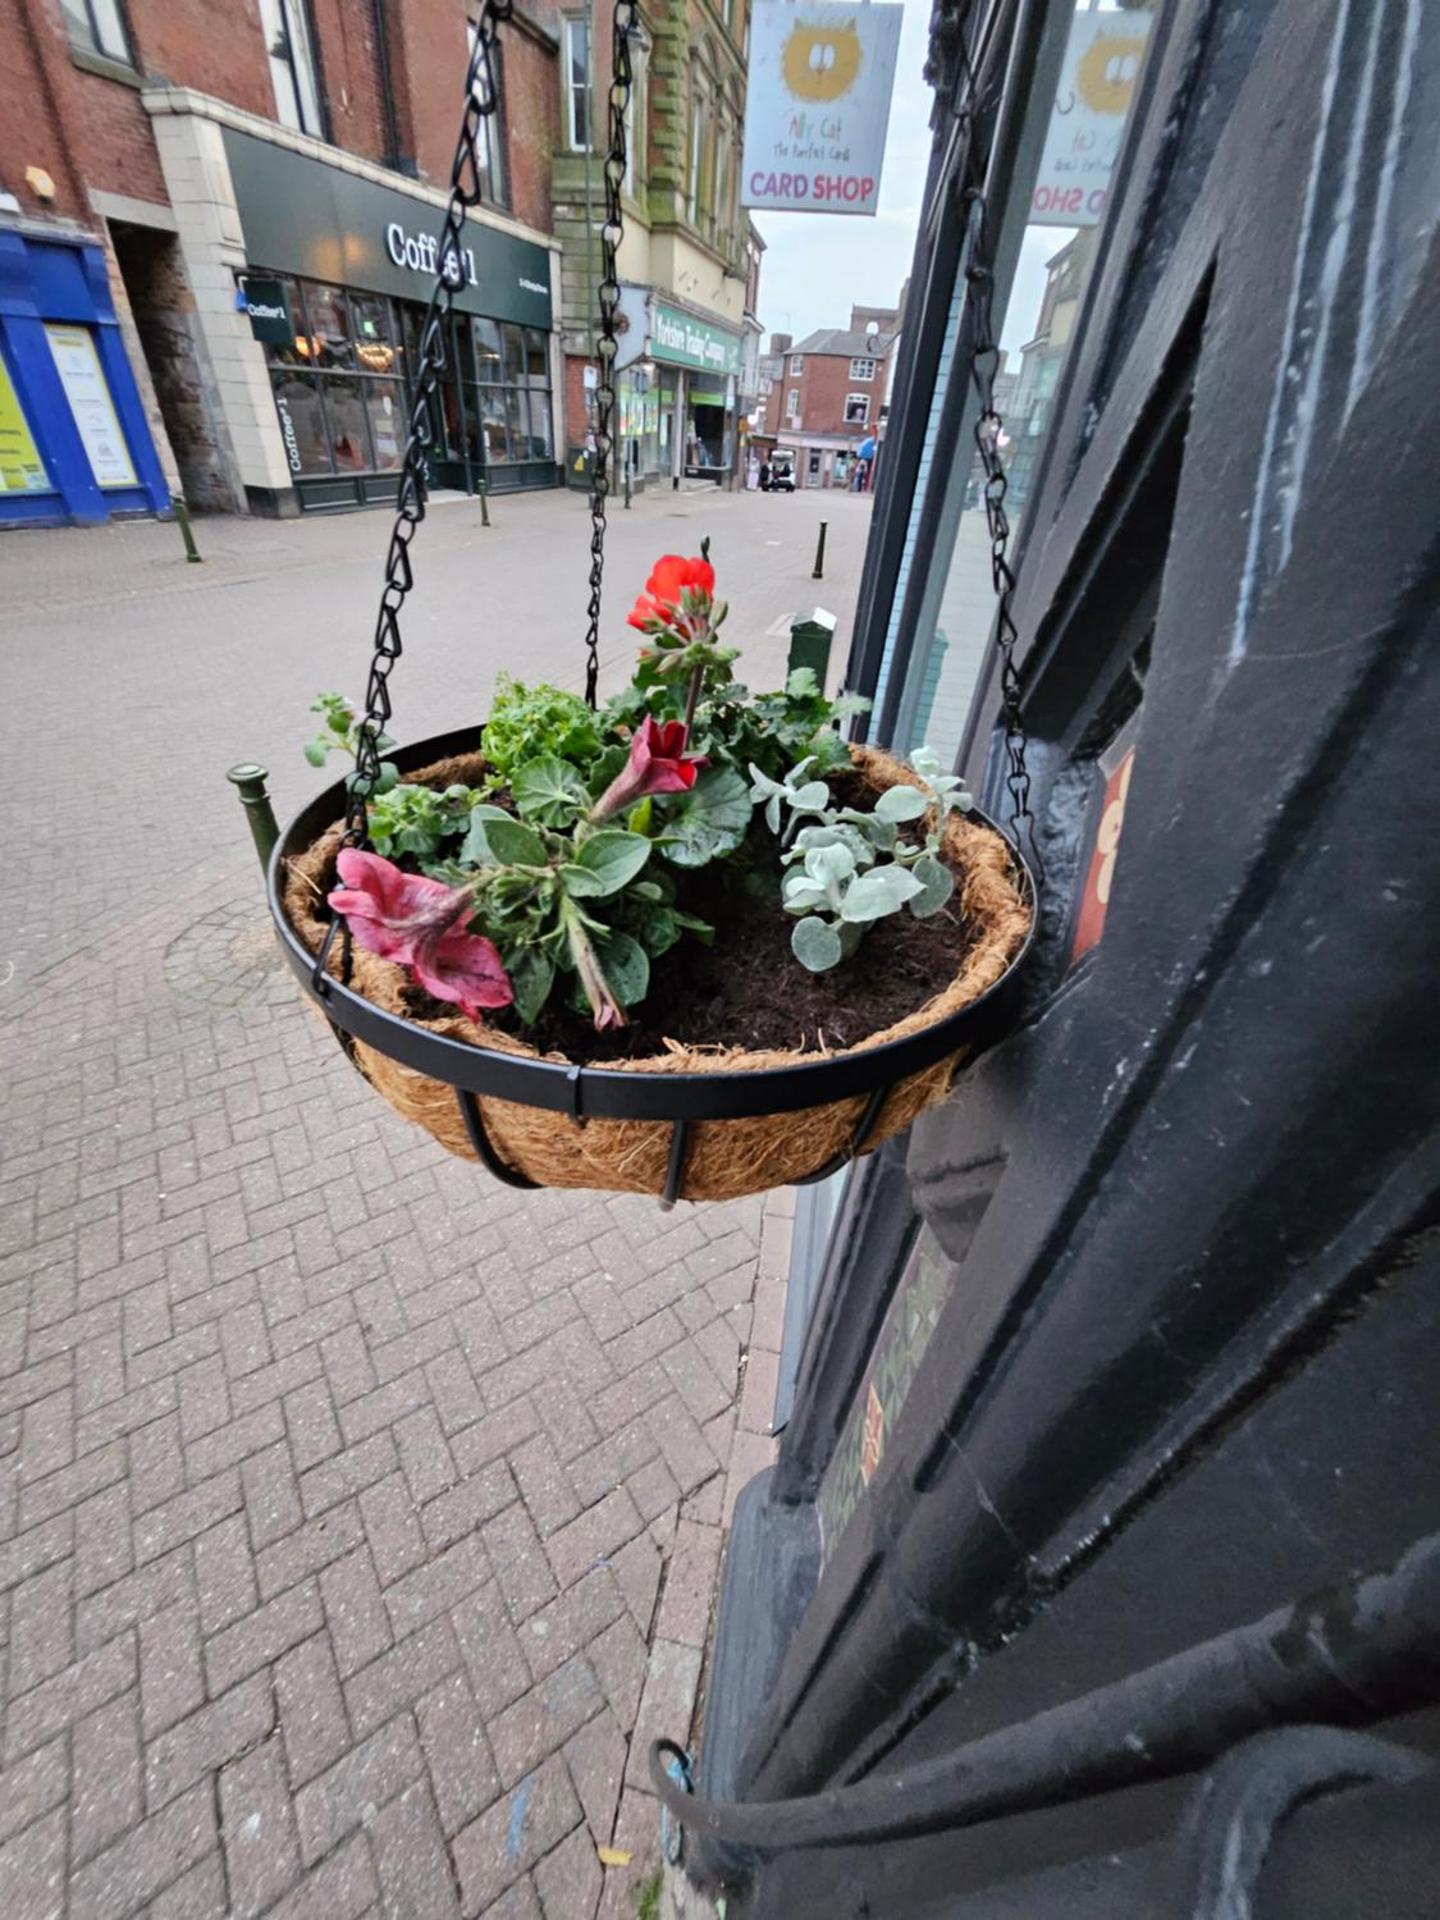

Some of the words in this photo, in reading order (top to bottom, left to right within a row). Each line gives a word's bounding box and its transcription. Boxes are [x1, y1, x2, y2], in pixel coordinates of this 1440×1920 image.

[820, 115, 842, 143] Cat
[750, 171, 809, 199] CARD
[812, 174, 875, 203] SHOP
